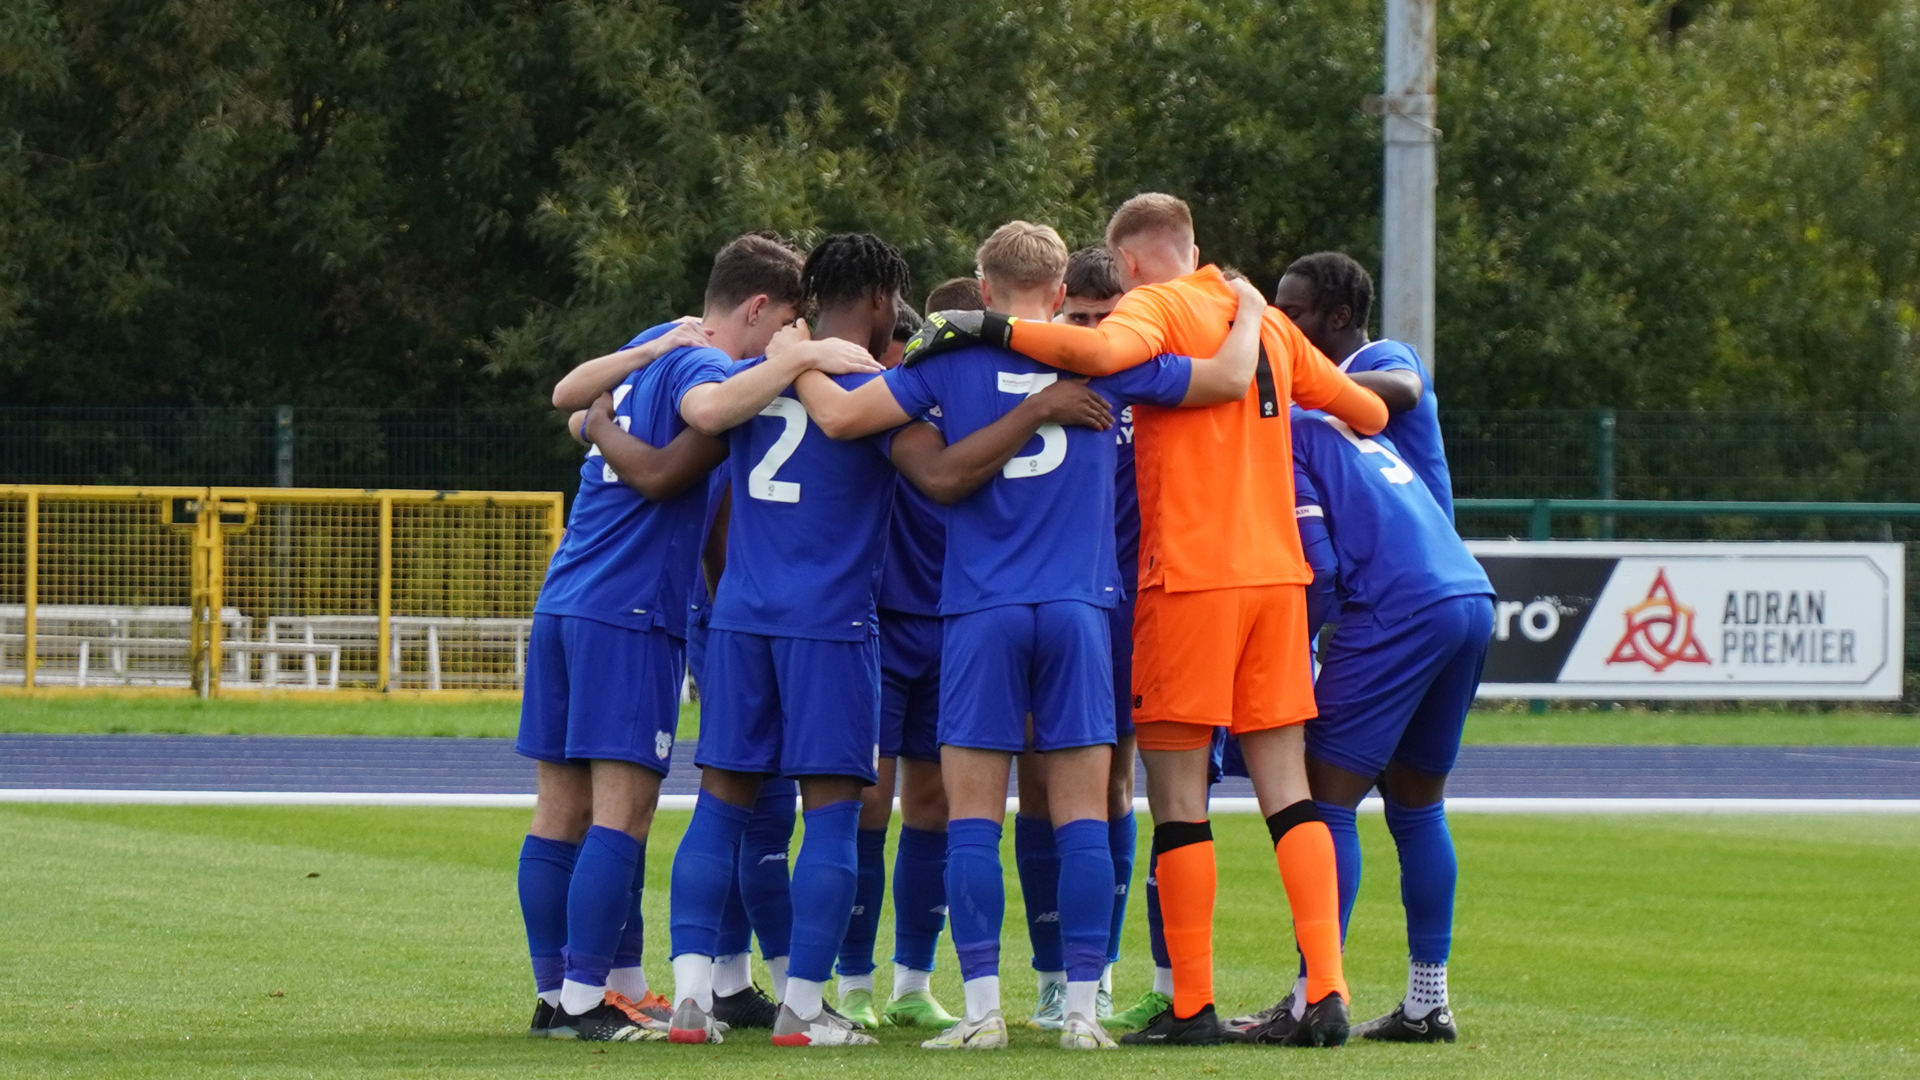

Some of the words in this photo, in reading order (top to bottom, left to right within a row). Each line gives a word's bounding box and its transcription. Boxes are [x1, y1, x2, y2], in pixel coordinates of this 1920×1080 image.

[748, 396, 808, 503] 2
[1323, 415, 1414, 485] 5
[1492, 600, 1560, 642] ro
[1722, 591, 1825, 625] ADRAN
[1722, 630, 1856, 664] PREMIER
